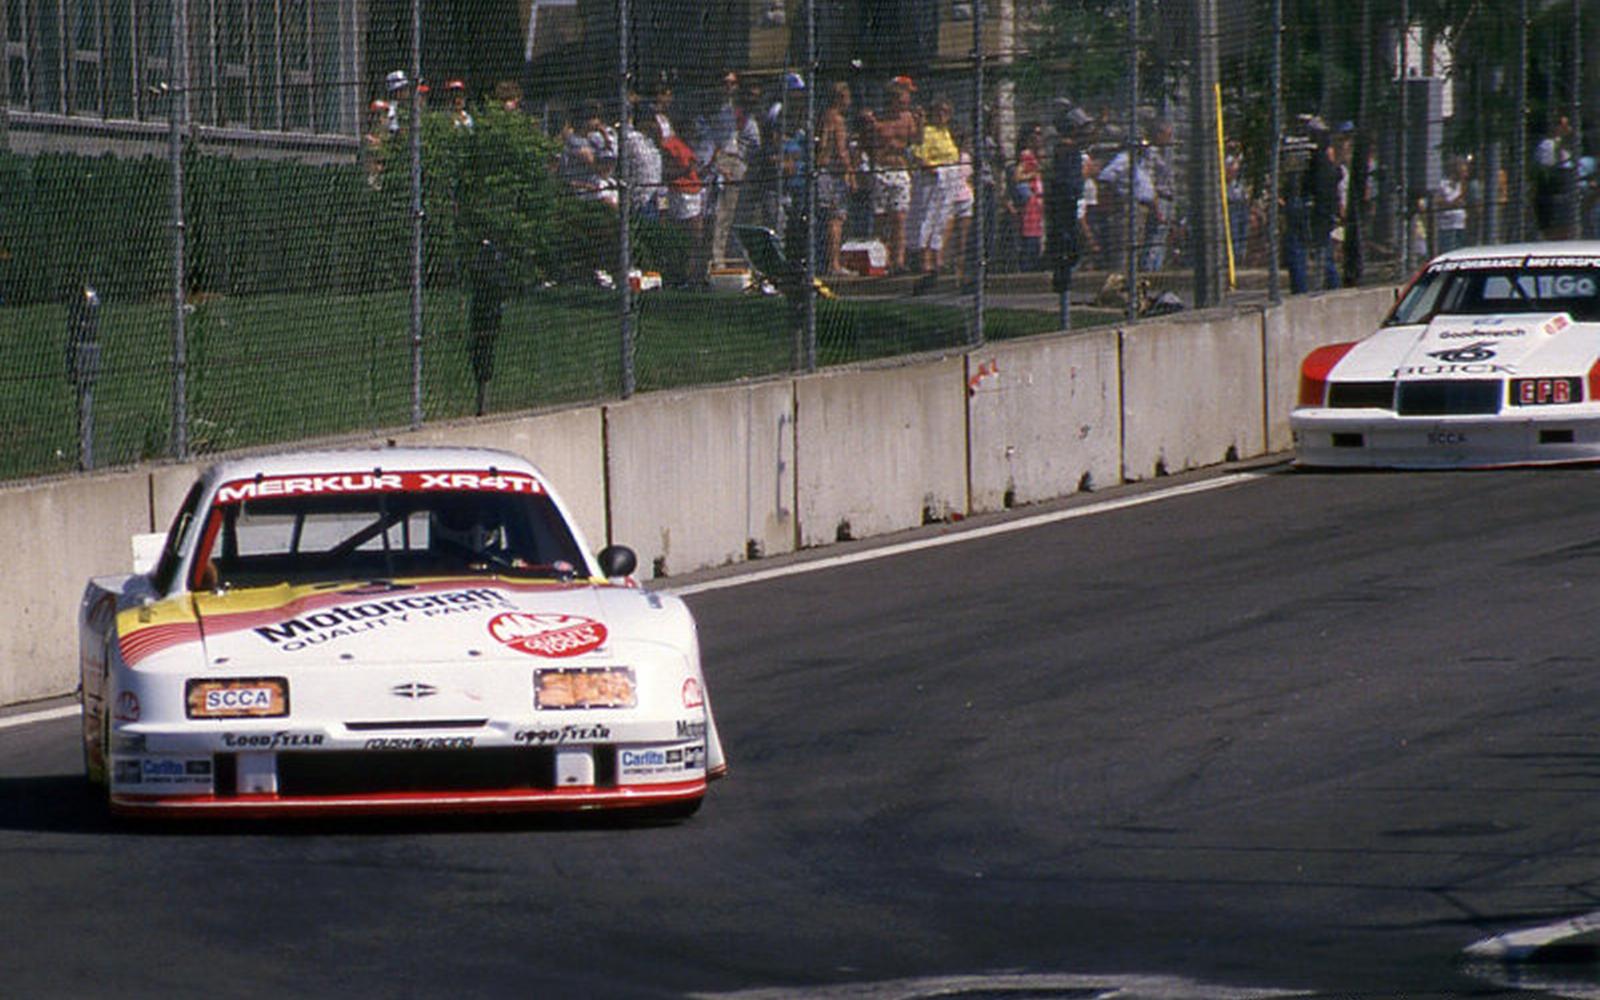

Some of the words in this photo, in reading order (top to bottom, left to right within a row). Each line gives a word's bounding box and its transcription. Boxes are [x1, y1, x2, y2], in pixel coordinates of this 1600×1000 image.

[1519, 380, 1570, 404] EFR
[217, 474, 403, 501] MERKUR
[254, 588, 505, 644] Motorcraft
[281, 613, 408, 652] QUALITY
[421, 600, 520, 618] PARTS
[208, 690, 270, 708] SCCA
